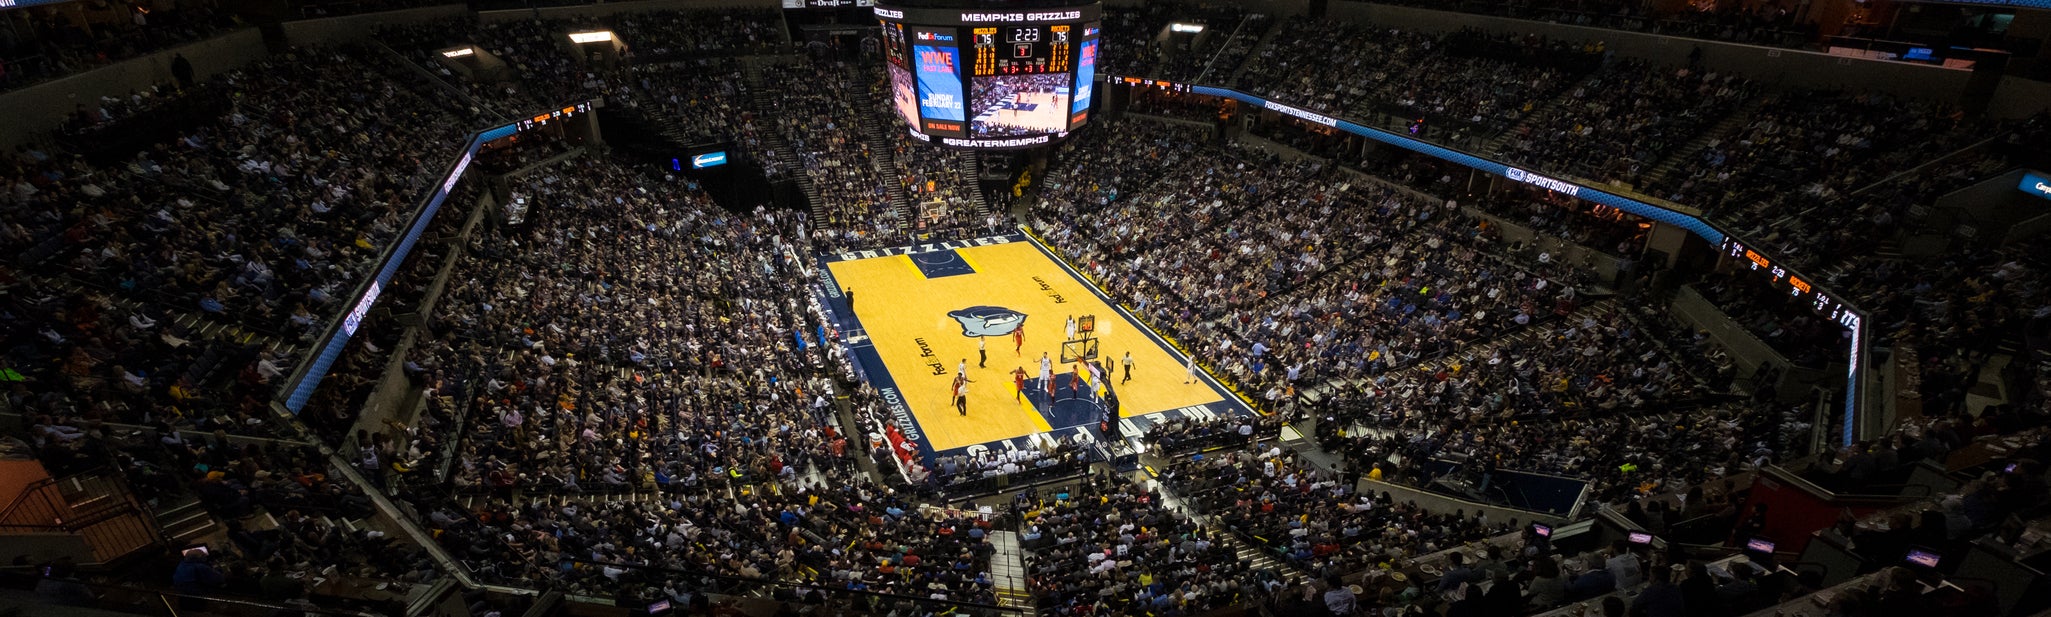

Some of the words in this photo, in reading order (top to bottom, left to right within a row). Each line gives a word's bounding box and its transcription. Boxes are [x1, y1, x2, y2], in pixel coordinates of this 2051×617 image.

[961, 13, 1024, 21] MEMPHIS
[1026, 11, 1081, 21] GRIZZLIES
[982, 34, 992, 44] 75
[1015, 28, 1039, 41] 2:23
[1057, 32, 1067, 41] 75
[1020, 48, 1025, 56] 3
[922, 51, 952, 66] WWE
[928, 93, 953, 101] SUNDAY
[922, 99, 953, 109] FEBRUARY
[1265, 100, 1337, 128] FOXSPORTSTENNESSEE.COM
[943, 136, 1048, 148] #GREATERMEMPHIS
[1525, 173, 1580, 197] SPORTSOUTH
[841, 236, 1010, 261] GRIZZLIES
[881, 387, 920, 441] GRIZZLIES.COM
